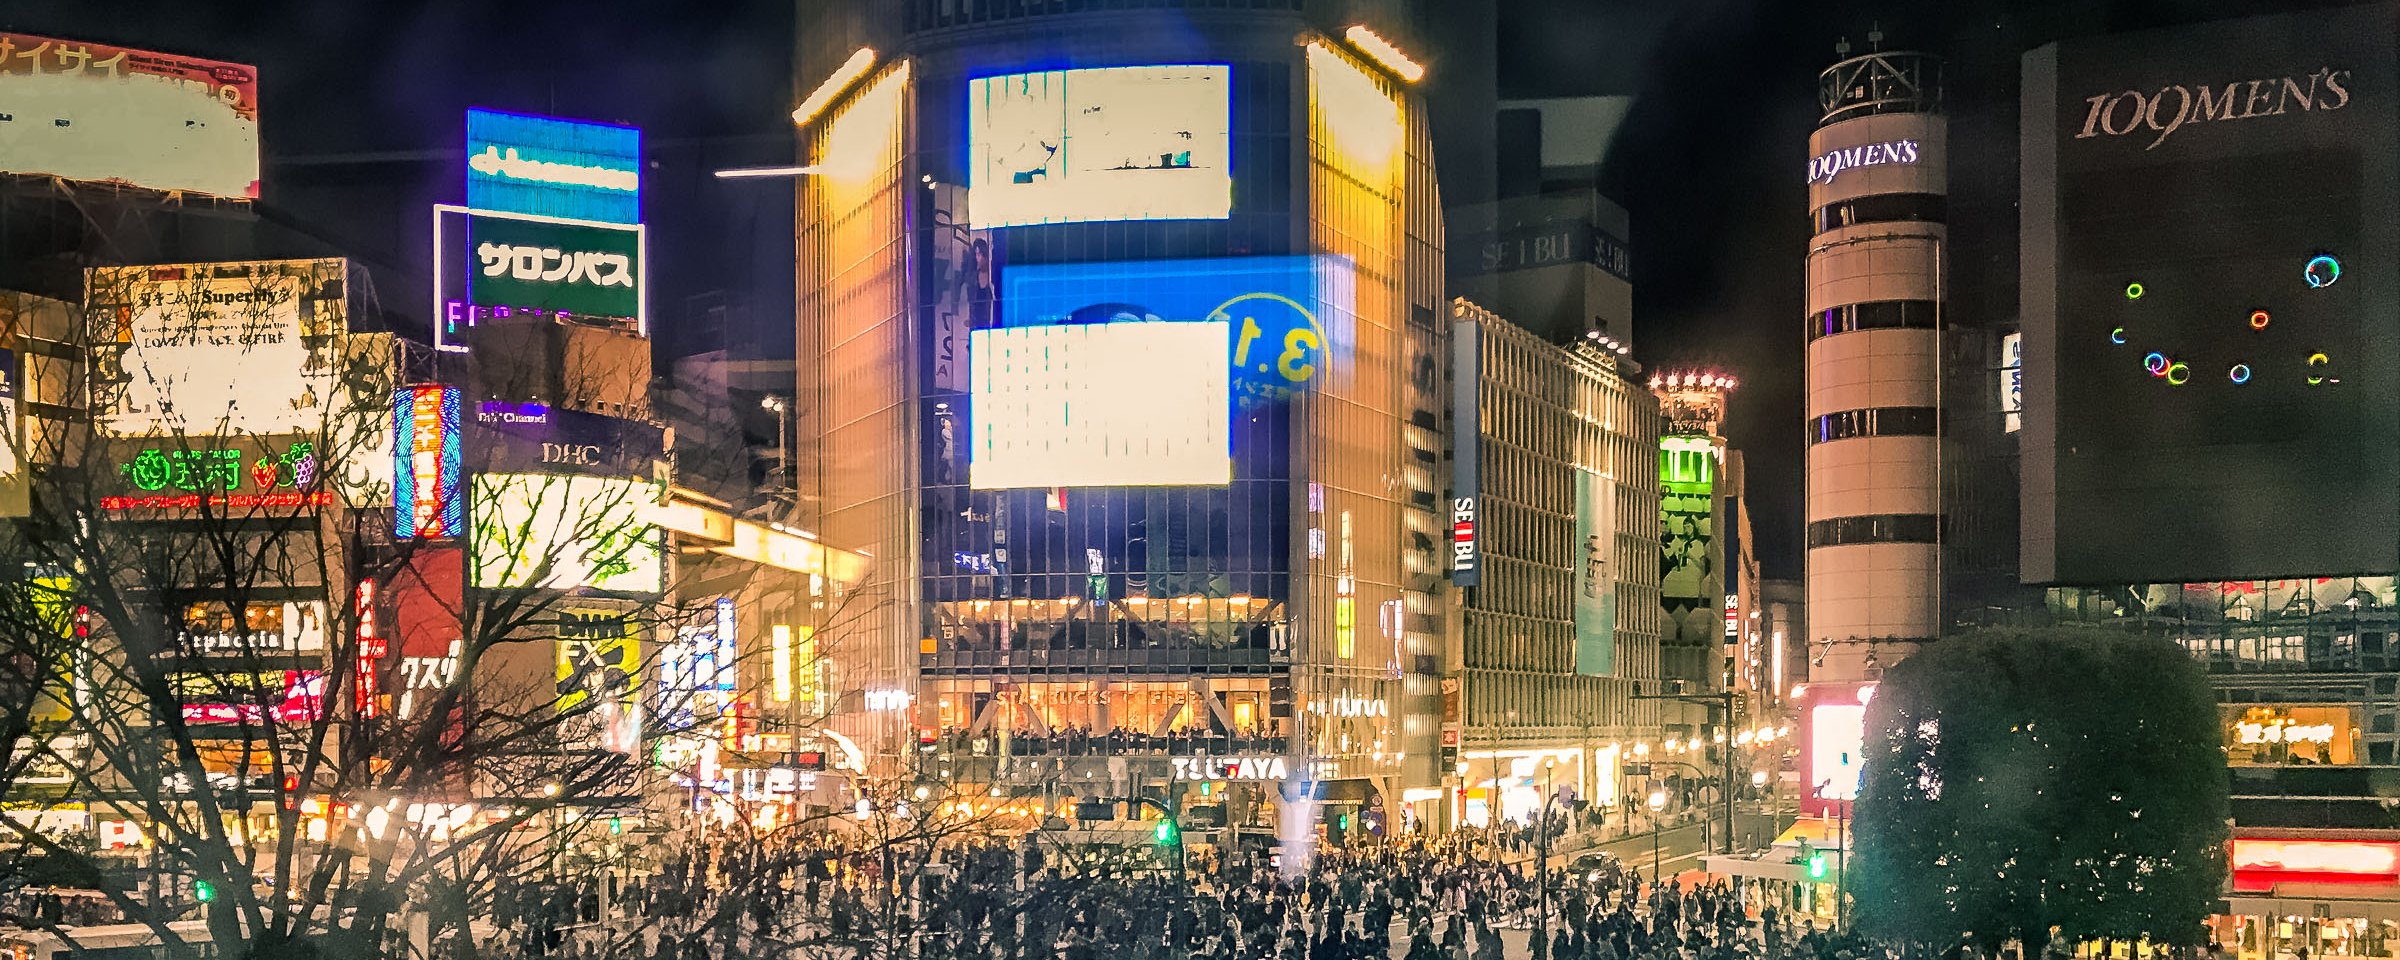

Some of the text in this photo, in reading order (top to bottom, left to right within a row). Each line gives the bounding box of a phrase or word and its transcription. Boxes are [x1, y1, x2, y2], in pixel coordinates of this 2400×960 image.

[477, 242, 633, 288] サロンパス
[541, 442, 600, 466] DHC
[1454, 497, 1474, 571] SEIBU
[559, 612, 624, 639] DMM
[1725, 594, 1738, 636] SEIBU
[176, 631, 280, 652] phoria
[559, 639, 605, 667] FX
[1171, 757, 1288, 781] TSUTAYA
